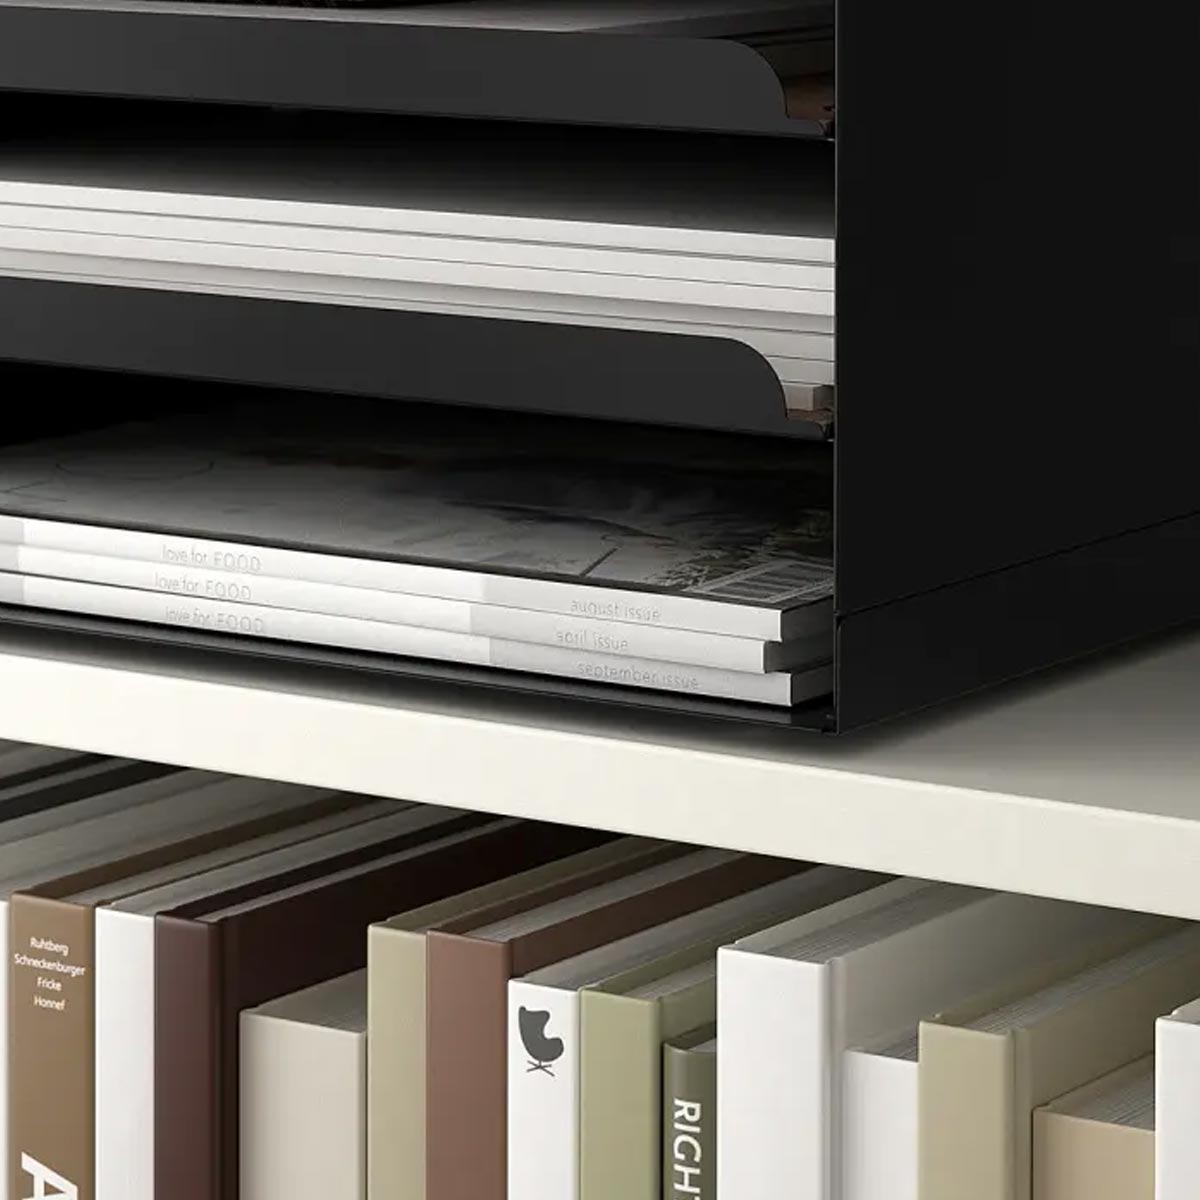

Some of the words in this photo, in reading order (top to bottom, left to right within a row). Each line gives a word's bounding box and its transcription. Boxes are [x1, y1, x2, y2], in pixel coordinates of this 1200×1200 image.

[162, 543, 188, 562] love
[214, 551, 261, 572] FOOD
[154, 571, 180, 590] love
[206, 579, 252, 600] FOOD
[217, 612, 264, 633] FOOD
[570, 599, 619, 617] august
[624, 605, 662, 621] issue
[592, 631, 629, 650] issue
[577, 662, 660, 685] september
[661, 672, 700, 690] issue
[673, 1097, 702, 1200] RIGH
